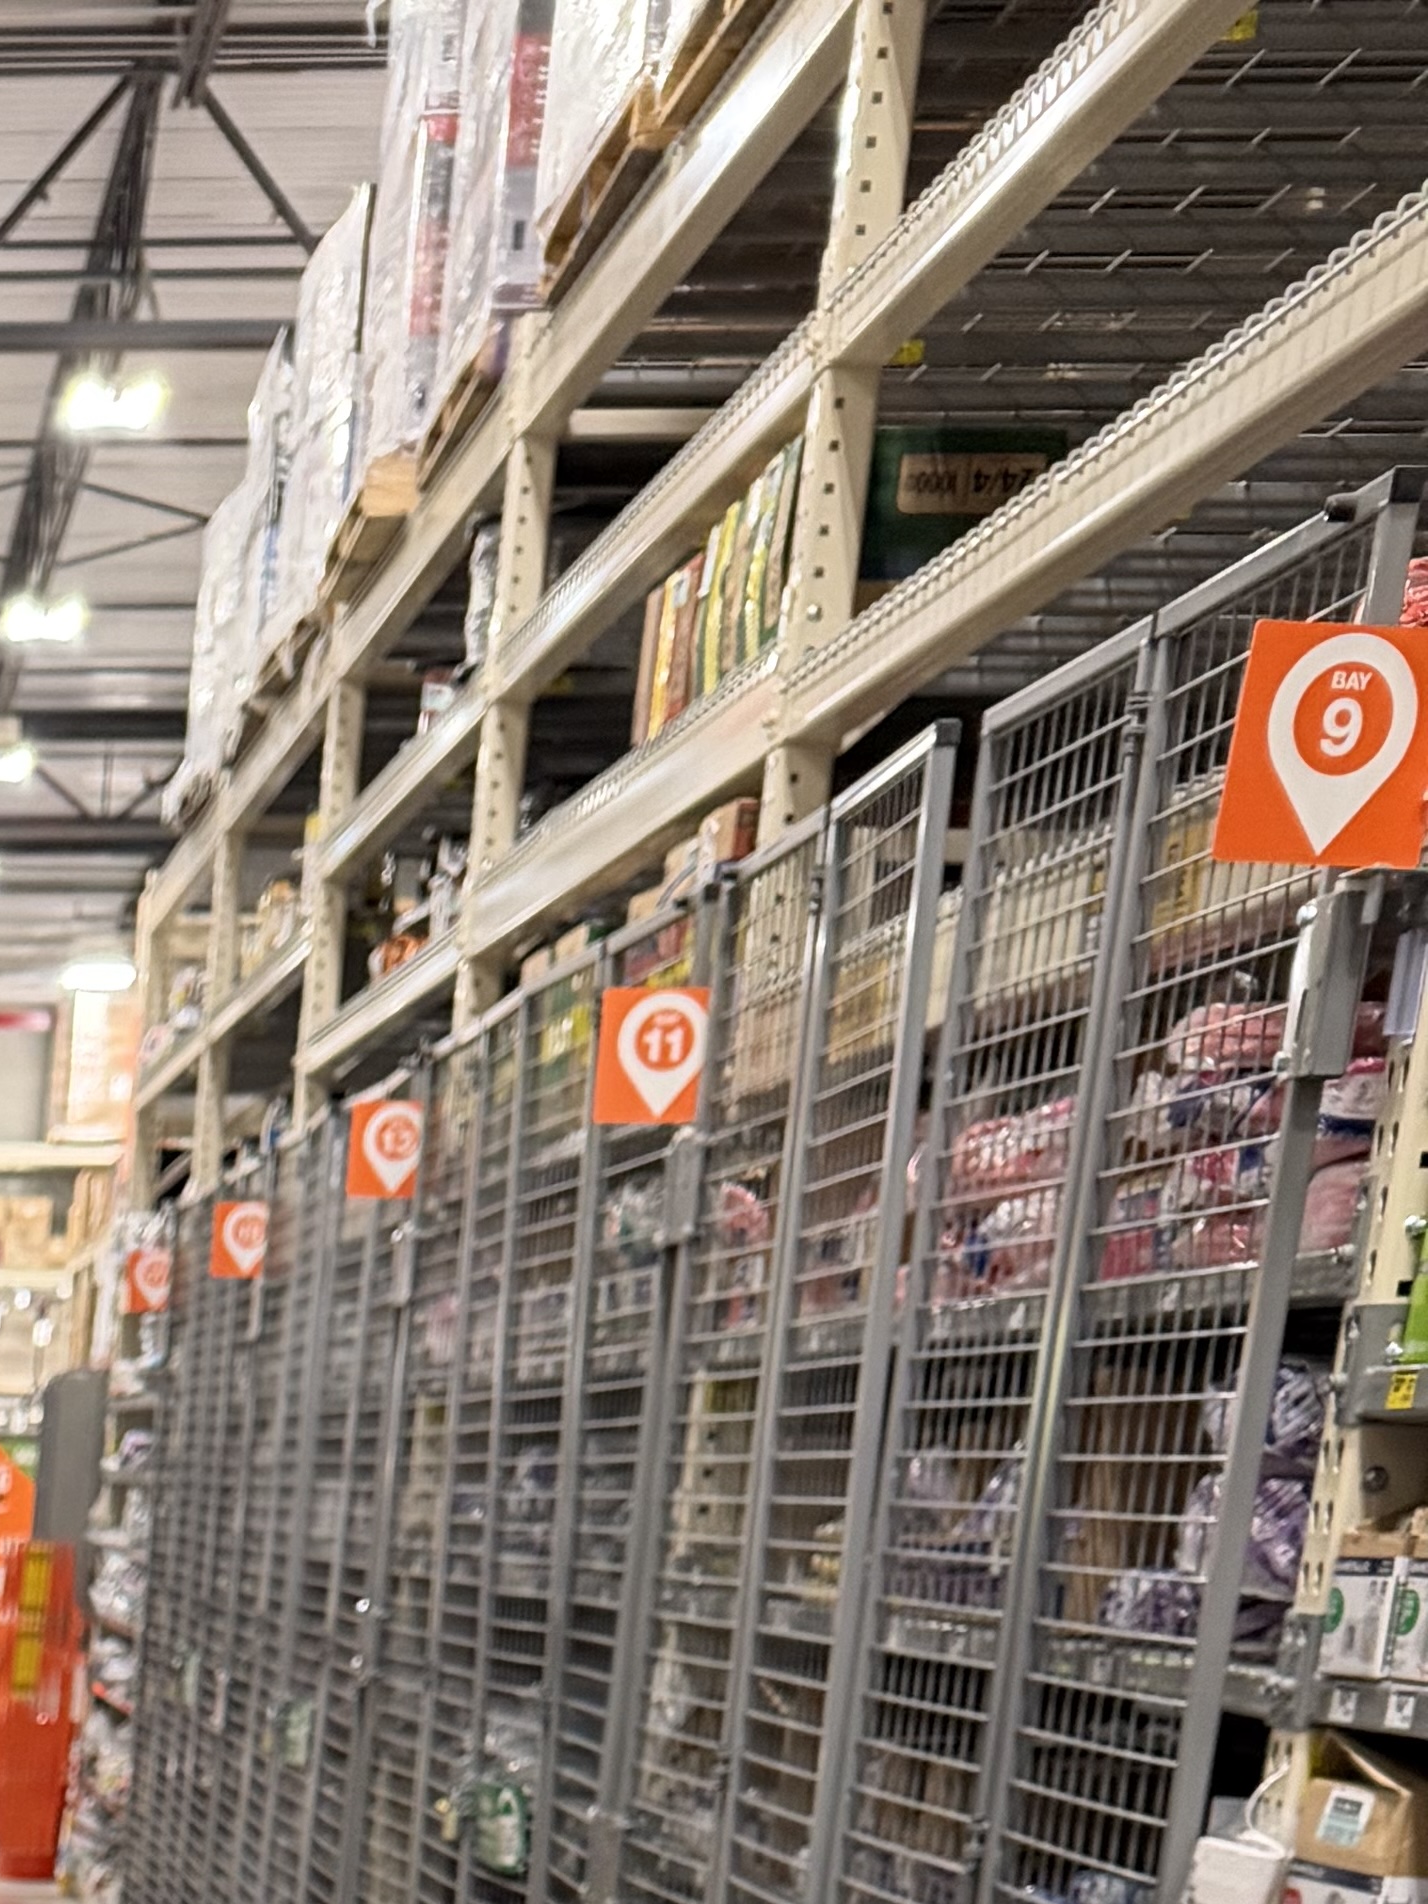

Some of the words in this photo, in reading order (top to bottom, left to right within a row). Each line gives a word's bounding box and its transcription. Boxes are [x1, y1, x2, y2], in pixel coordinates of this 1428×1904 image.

[1331, 670, 1373, 691] BAY
[1320, 697, 1363, 757] 9
[642, 1025, 686, 1063] 11
